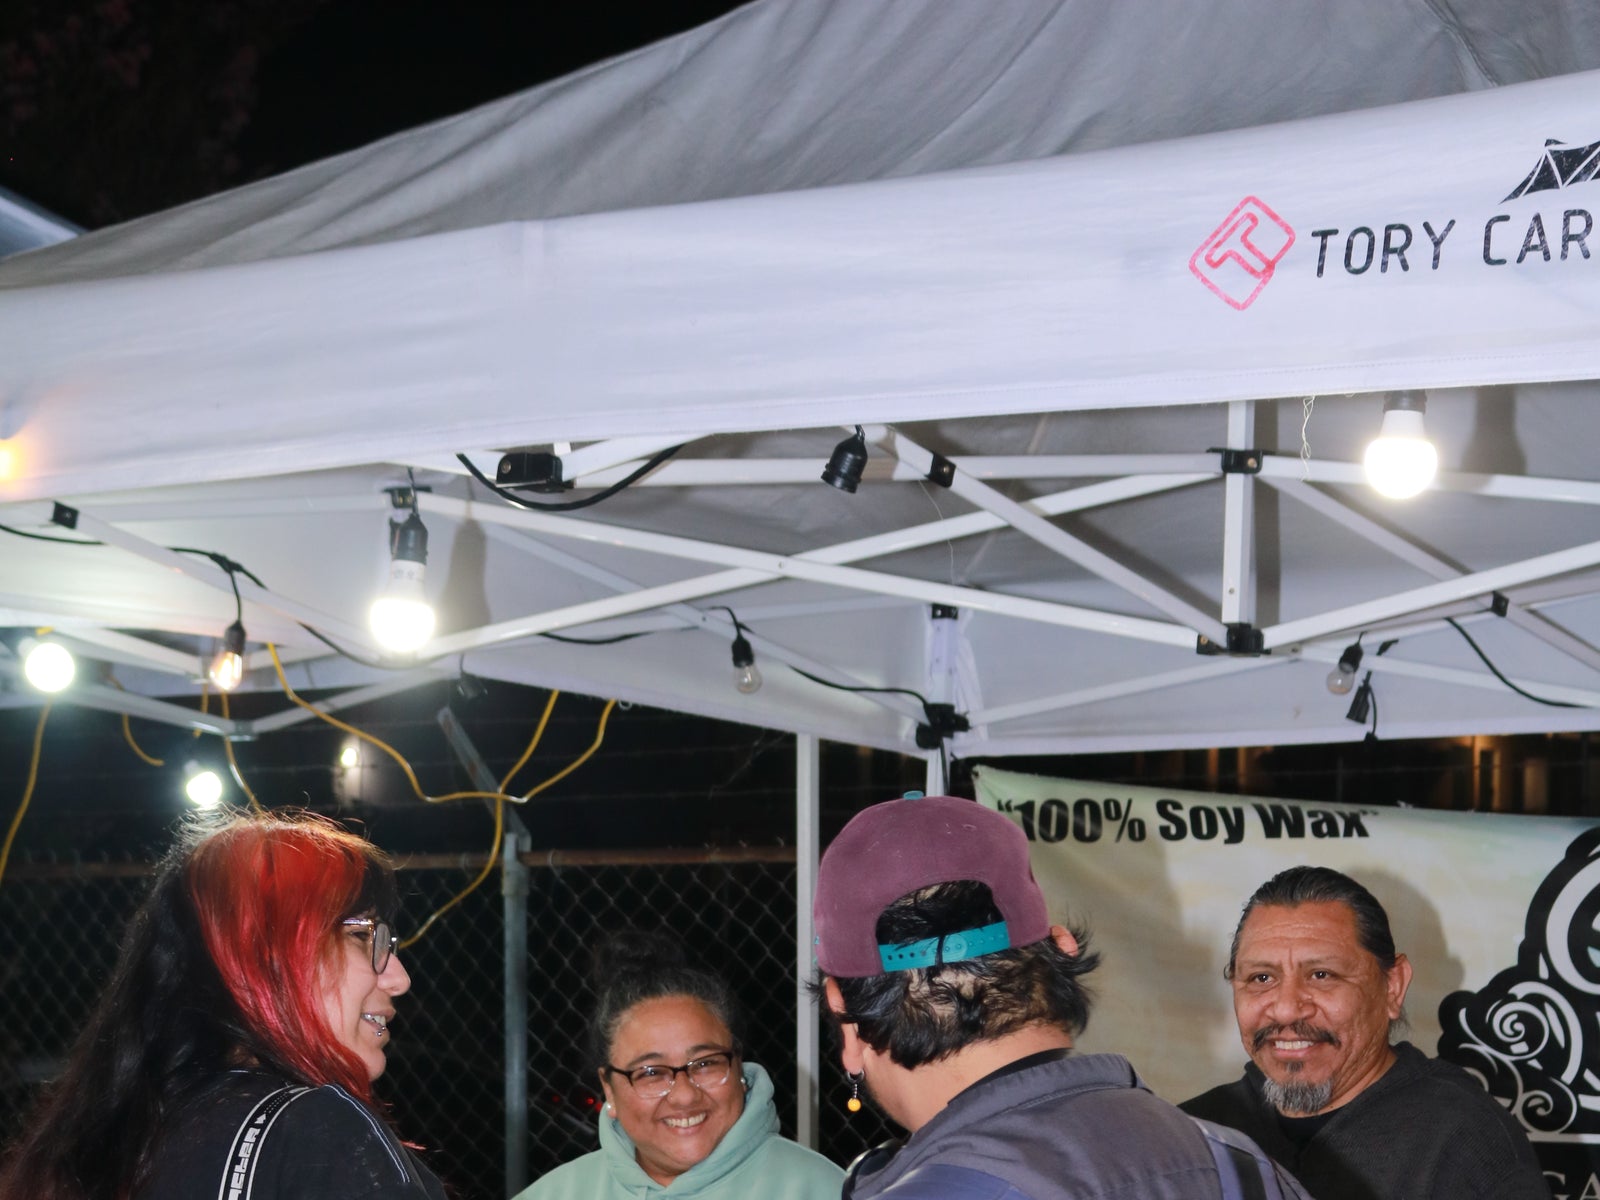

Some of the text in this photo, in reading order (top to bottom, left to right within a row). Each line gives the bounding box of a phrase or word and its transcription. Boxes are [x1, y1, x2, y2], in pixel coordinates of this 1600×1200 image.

[1311, 208, 1591, 278] TORY CAR
[1156, 799, 1245, 845] Soy
